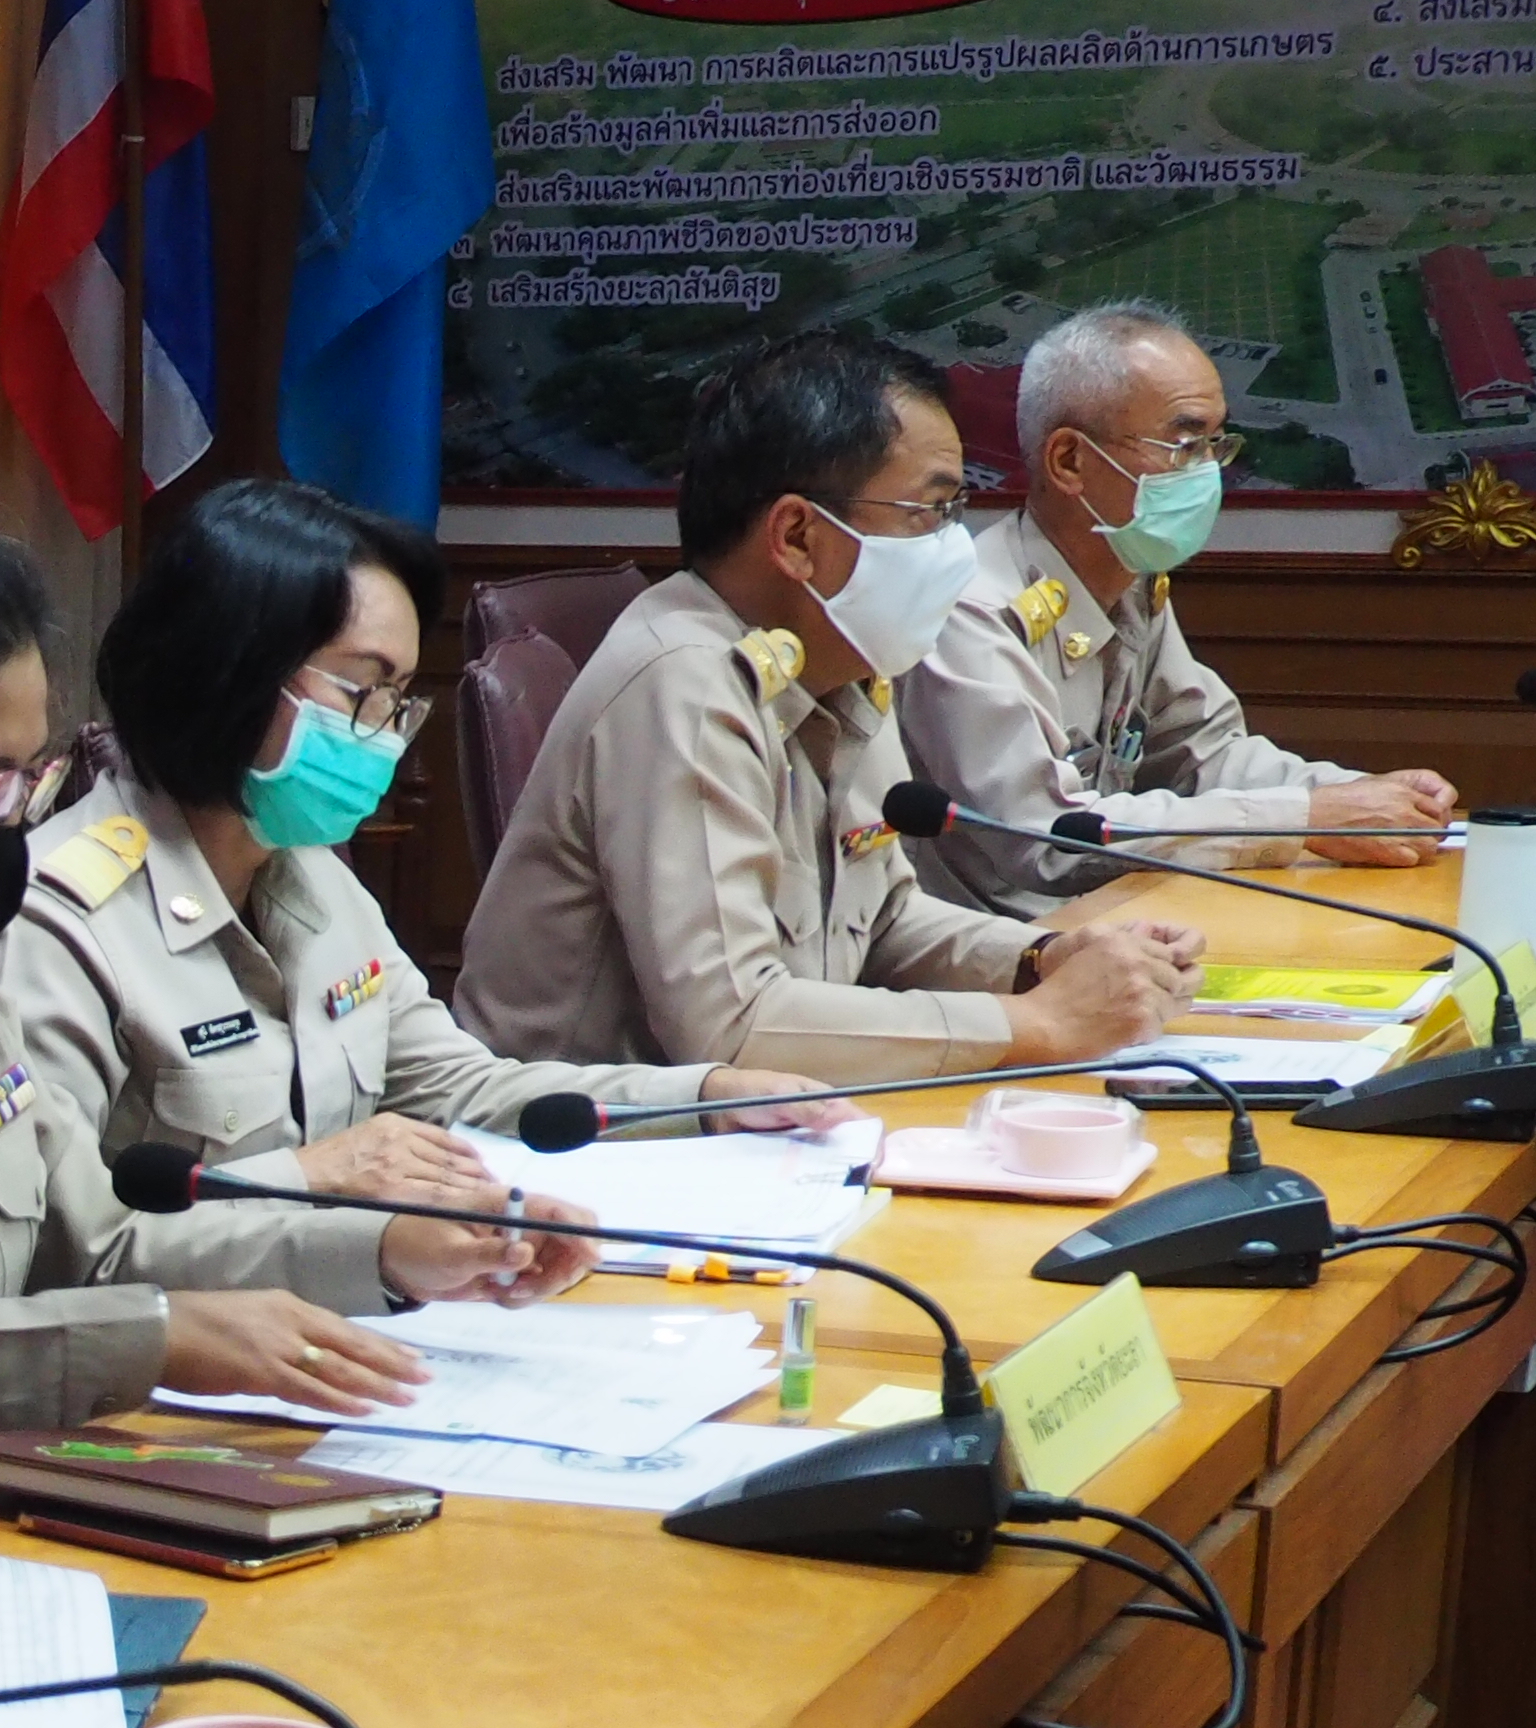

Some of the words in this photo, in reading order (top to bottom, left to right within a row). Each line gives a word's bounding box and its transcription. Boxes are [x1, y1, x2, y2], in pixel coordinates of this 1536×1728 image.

[501, 58, 594, 90] ส่งเสริม
[608, 54, 692, 85] พัฒนา
[705, 29, 1334, 81] การผลิตและการแปรรูปผลผลิตด้านการเกษตร
[1414, 46, 1533, 76] ประสาน
[502, 102, 937, 150] เพื่อสร้างมูลค่าเพิ่มและการส่งออก
[499, 156, 1081, 204] ส่งเสริมและพัฒนาการท่องเที่ยวเชิงธรรมชาติ
[1095, 153, 1297, 186] และวัฒนธรรม
[494, 216, 913, 260] พัฒนาคุณภาพชีวิตของประชาชน
[491, 269, 776, 309] เสริมสร้างยะลาสันติสุข
